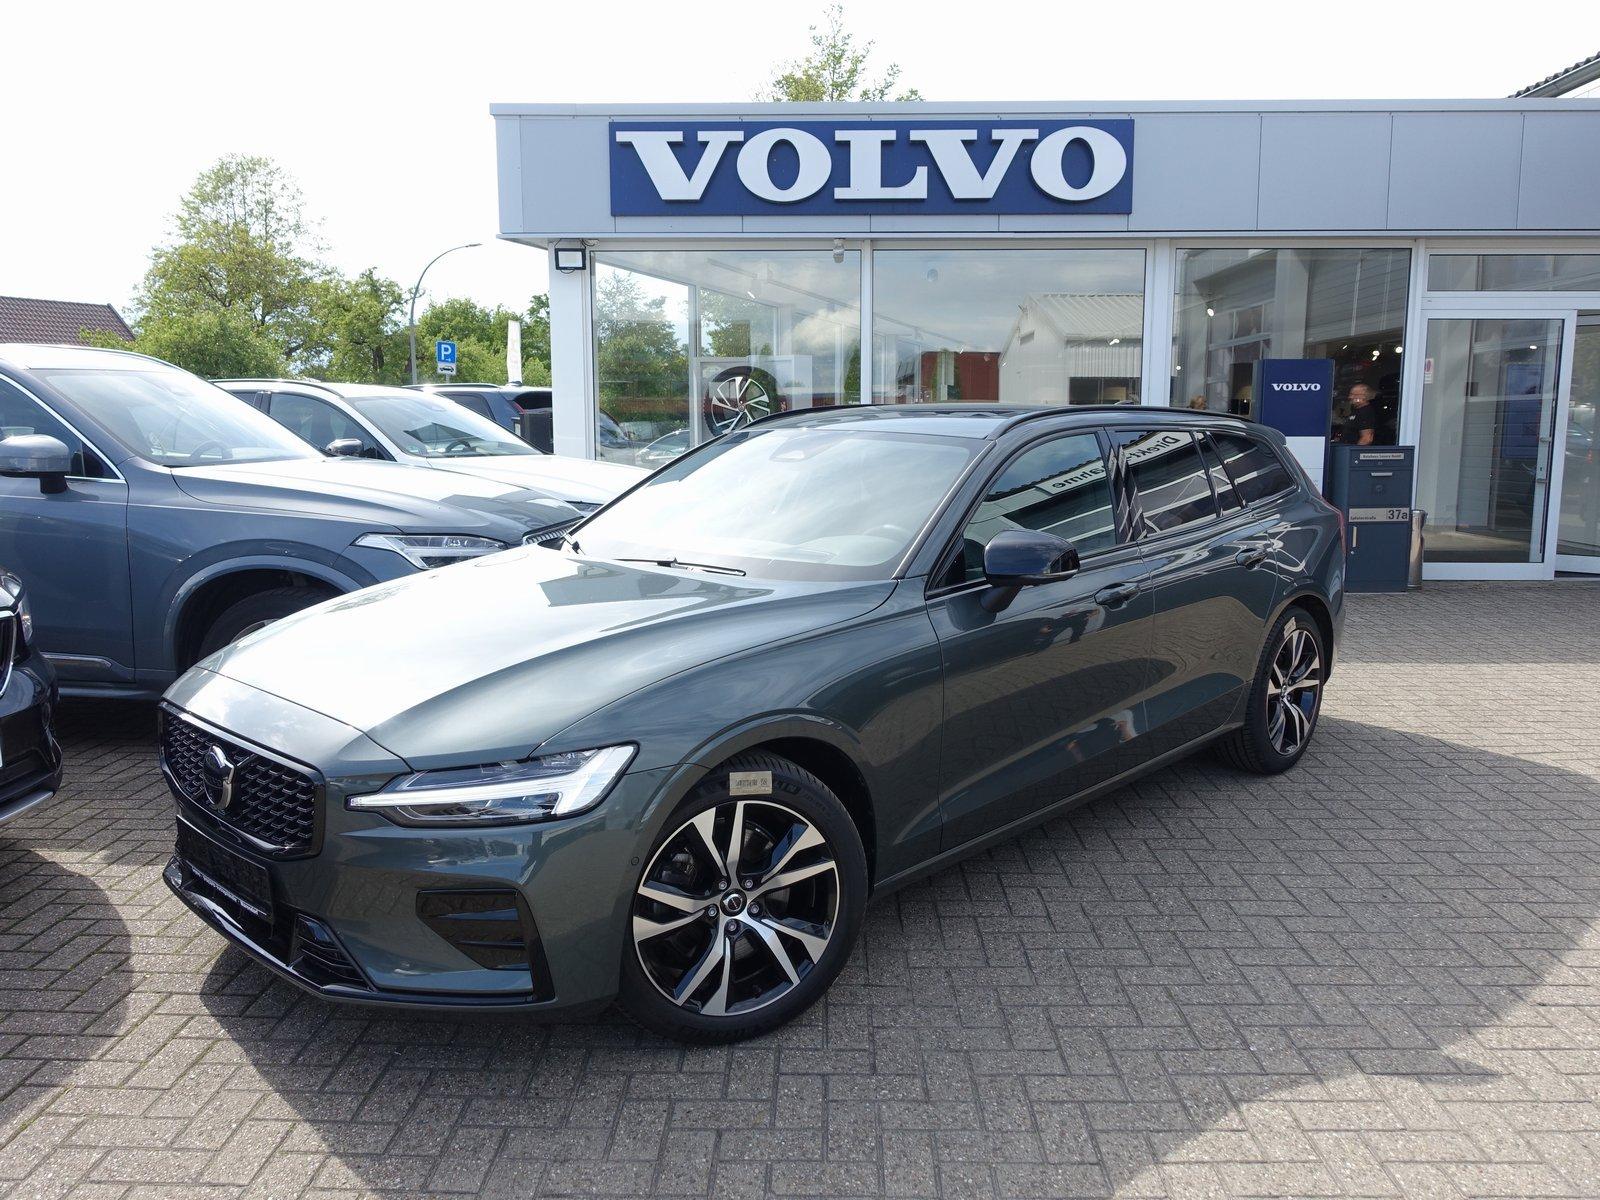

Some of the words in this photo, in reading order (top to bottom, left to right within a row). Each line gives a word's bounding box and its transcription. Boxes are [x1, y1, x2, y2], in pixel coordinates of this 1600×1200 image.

[615, 125, 1128, 203] VOLVO
[441, 344, 452, 361] P
[1271, 382, 1321, 392] VOLVO
[1388, 509, 1408, 520] 37a
